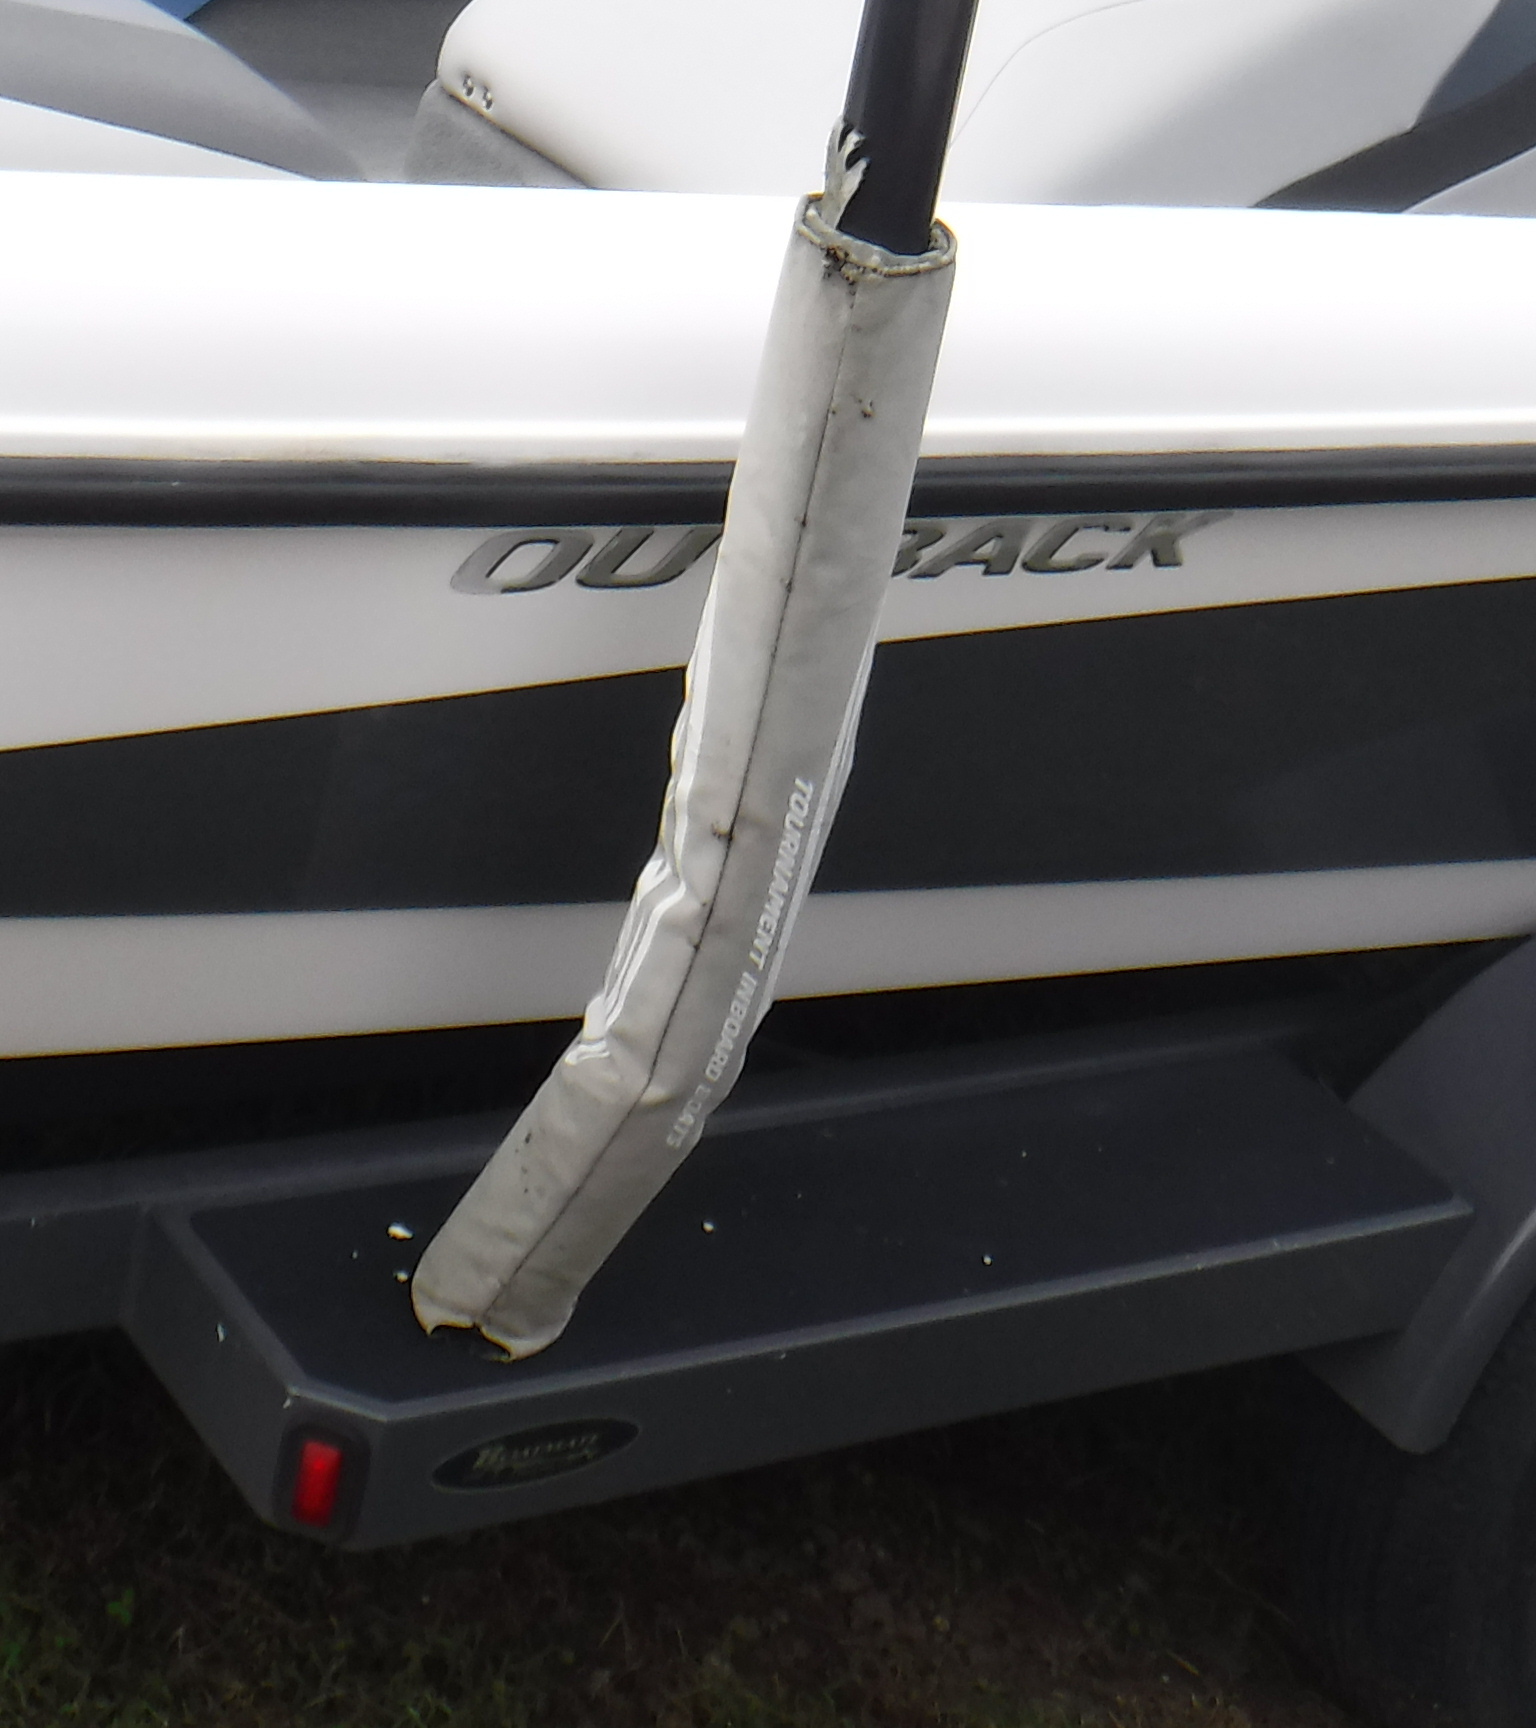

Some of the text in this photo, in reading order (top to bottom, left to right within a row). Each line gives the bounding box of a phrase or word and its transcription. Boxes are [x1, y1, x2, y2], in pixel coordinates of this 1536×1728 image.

[450, 509, 1232, 595] OUBACK
[748, 777, 813, 971] TOURNAMENT
[705, 970, 758, 1082] INBOARD
